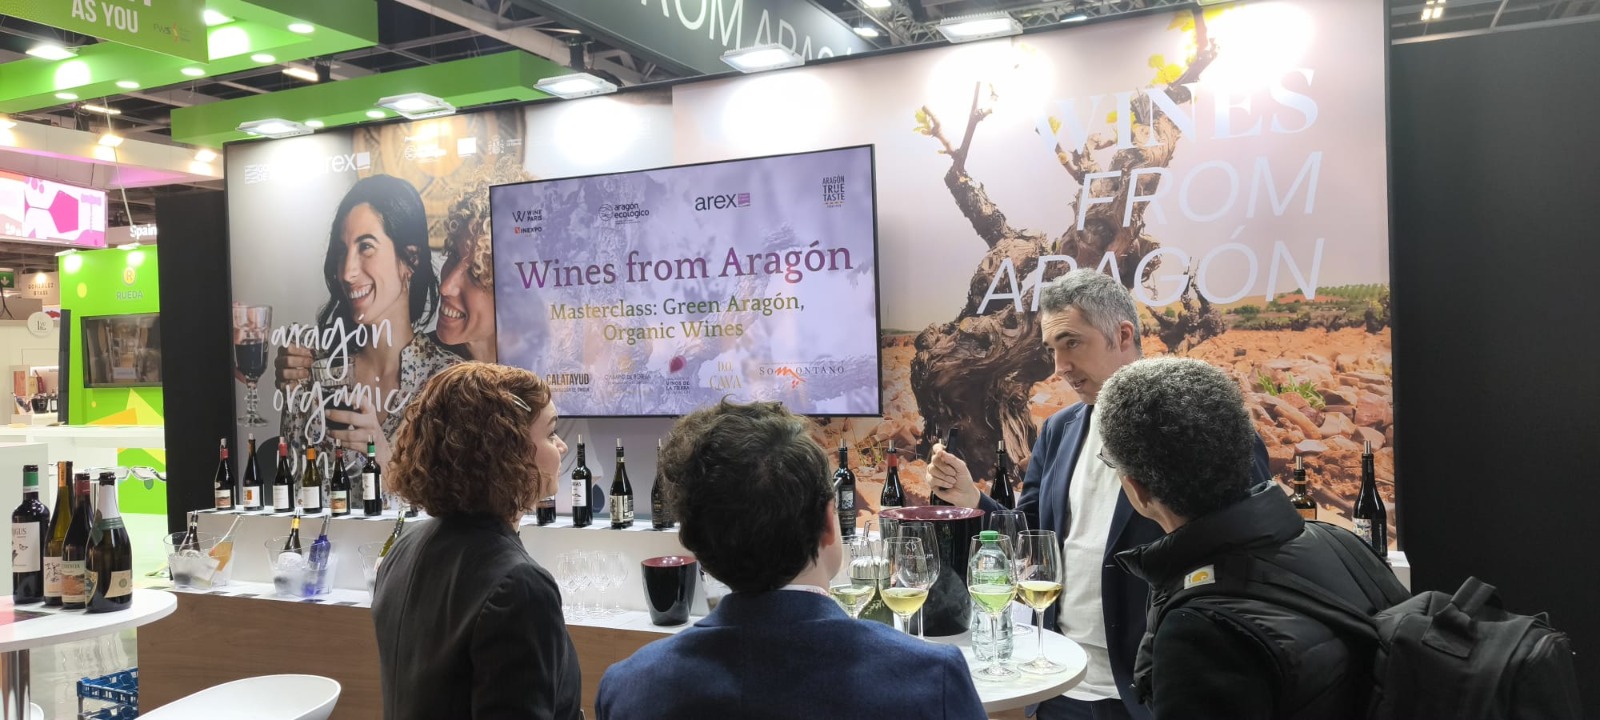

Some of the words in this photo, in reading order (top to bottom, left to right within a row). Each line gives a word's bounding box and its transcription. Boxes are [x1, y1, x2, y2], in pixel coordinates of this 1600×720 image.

[71, 0, 97, 23] AS
[101, 2, 139, 33] YOU
[1035, 68, 1319, 155] WINES
[823, 183, 845, 194] TRUE
[823, 193, 845, 202] TASTE
[1077, 151, 1323, 231] FROM
[695, 193, 737, 212] arex
[130, 224, 158, 240] Spain
[514, 258, 616, 290] Wines
[625, 250, 710, 283] from
[718, 240, 853, 284] Aragón
[116, 290, 143, 300] RUEDA
[550, 298, 657, 321] Masterclass:
[662, 297, 721, 316] Green
[726, 292, 805, 317] Aragón,
[603, 322, 675, 346] Organic
[680, 320, 744, 338] Wines
[271, 314, 392, 381] aragón
[546, 373, 590, 386] CALATAYUD
[709, 375, 742, 391] CAVA
[273, 376, 411, 444] organic
